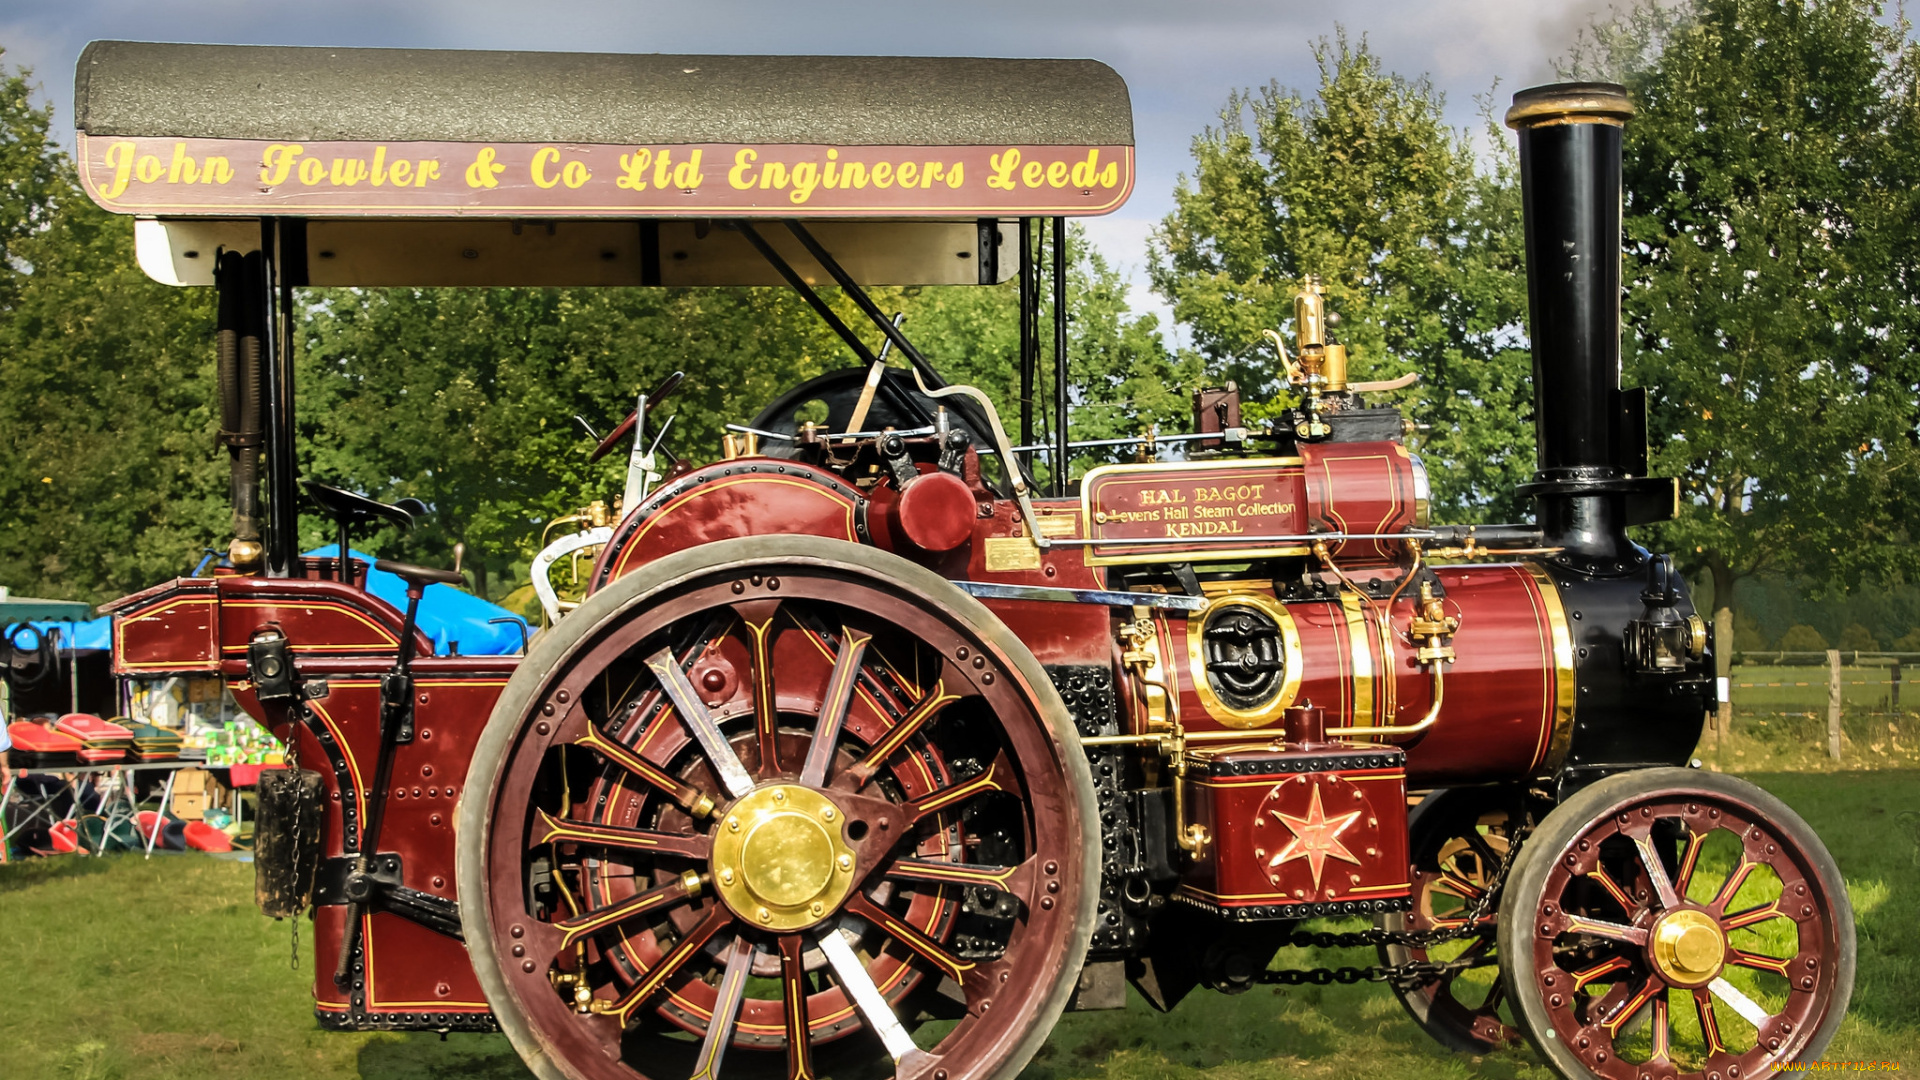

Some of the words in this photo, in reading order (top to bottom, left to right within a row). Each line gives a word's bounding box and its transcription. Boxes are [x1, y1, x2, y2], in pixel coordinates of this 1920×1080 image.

[99, 143, 236, 200] John
[262, 145, 441, 188] Fowler
[466, 147, 506, 189] &
[531, 148, 593, 190] Co
[616, 149, 704, 191] Ltd
[729, 149, 965, 204] Engineers
[988, 149, 1120, 190] Leeds
[1140, 489, 1186, 504] HAL
[1195, 484, 1265, 502] BAGOT
[1163, 506, 1189, 520] Hall
[1193, 505, 1234, 518] Steam
[1237, 502, 1296, 517] Collection
[1166, 520, 1244, 538] KENDAL
